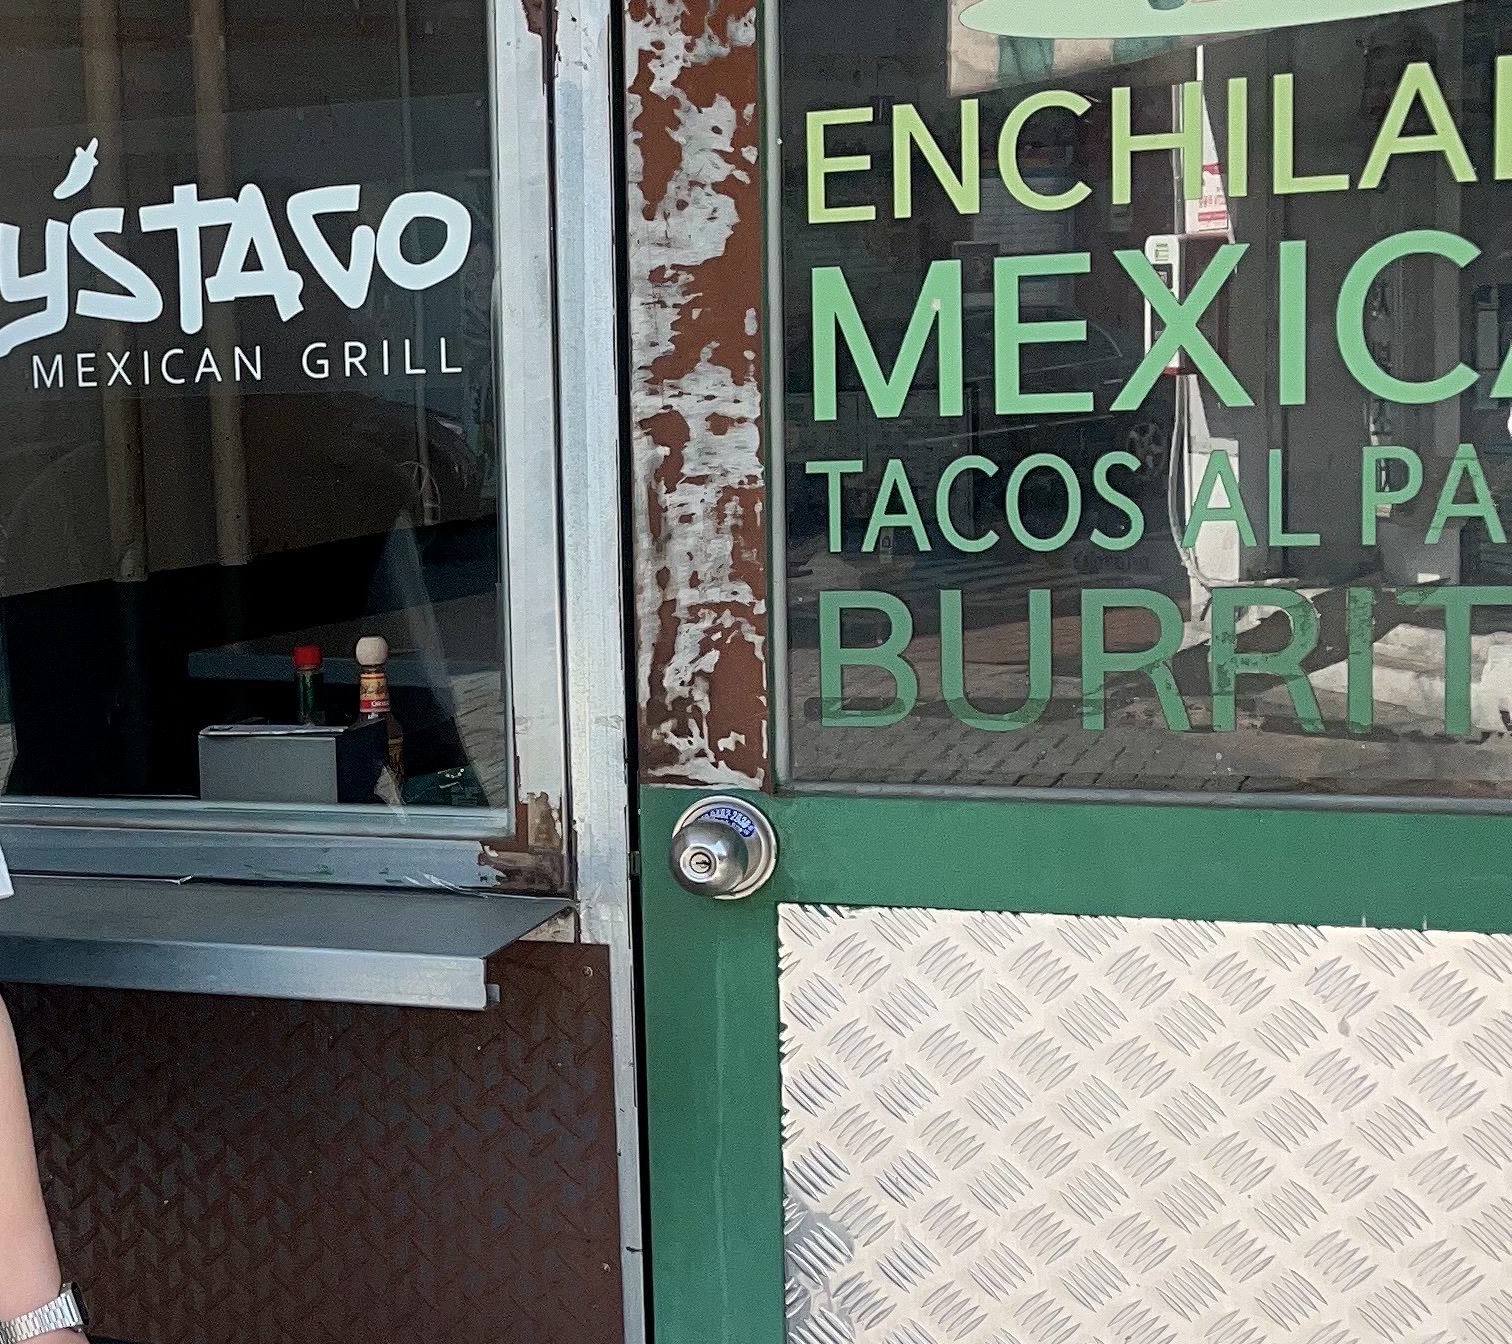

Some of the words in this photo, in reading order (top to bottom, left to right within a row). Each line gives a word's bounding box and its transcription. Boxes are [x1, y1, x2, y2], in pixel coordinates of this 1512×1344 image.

[805, 56, 1512, 225] ENCHILA
[31, 345, 263, 390] MEXICAN
[301, 337, 464, 380] GRILL
[810, 229, 1512, 422] MEXIC
[804, 451, 1145, 553] TACOS
[1182, 448, 1320, 550] AL
[1360, 443, 1508, 546] PA
[817, 585, 1512, 738] BURRIT
